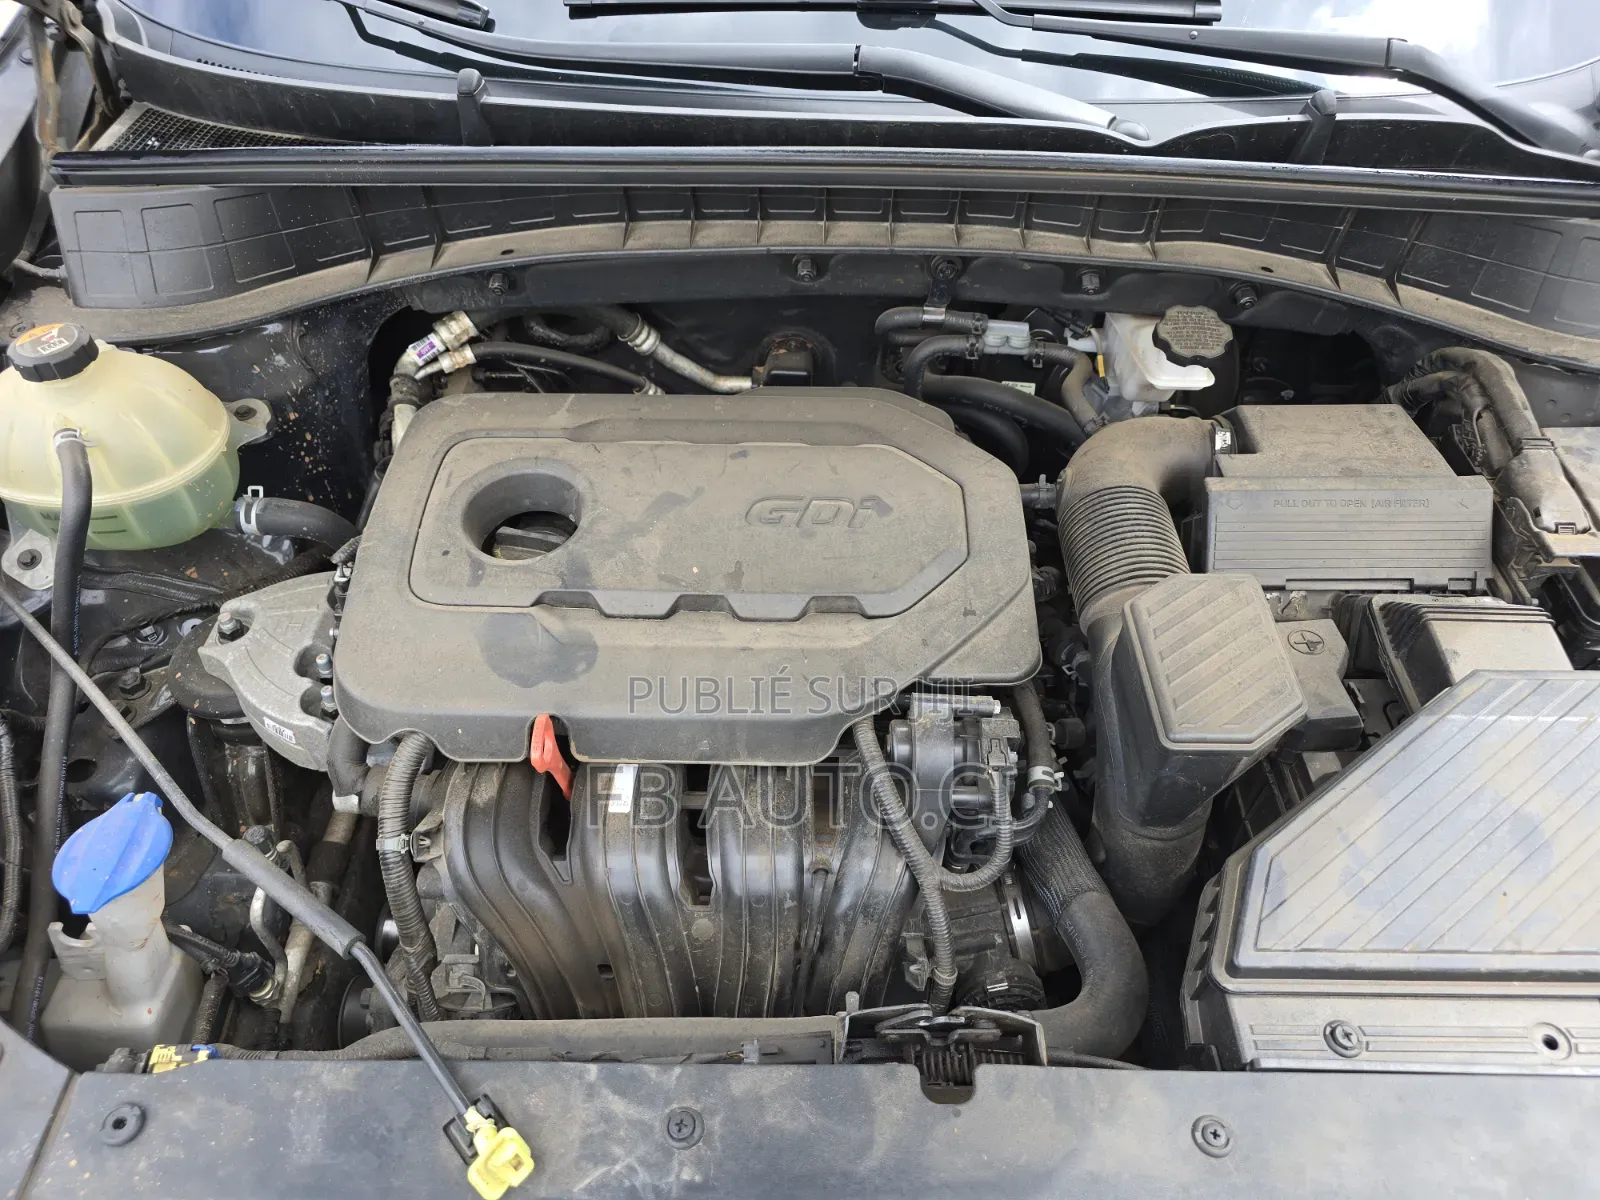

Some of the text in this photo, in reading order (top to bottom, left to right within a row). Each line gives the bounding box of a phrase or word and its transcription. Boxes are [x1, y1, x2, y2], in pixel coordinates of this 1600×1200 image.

[1273, 499, 1299, 508] PULL
[1301, 499, 1321, 508] OUT
[1325, 499, 1337, 508] TO
[1340, 499, 1367, 508] OPEN
